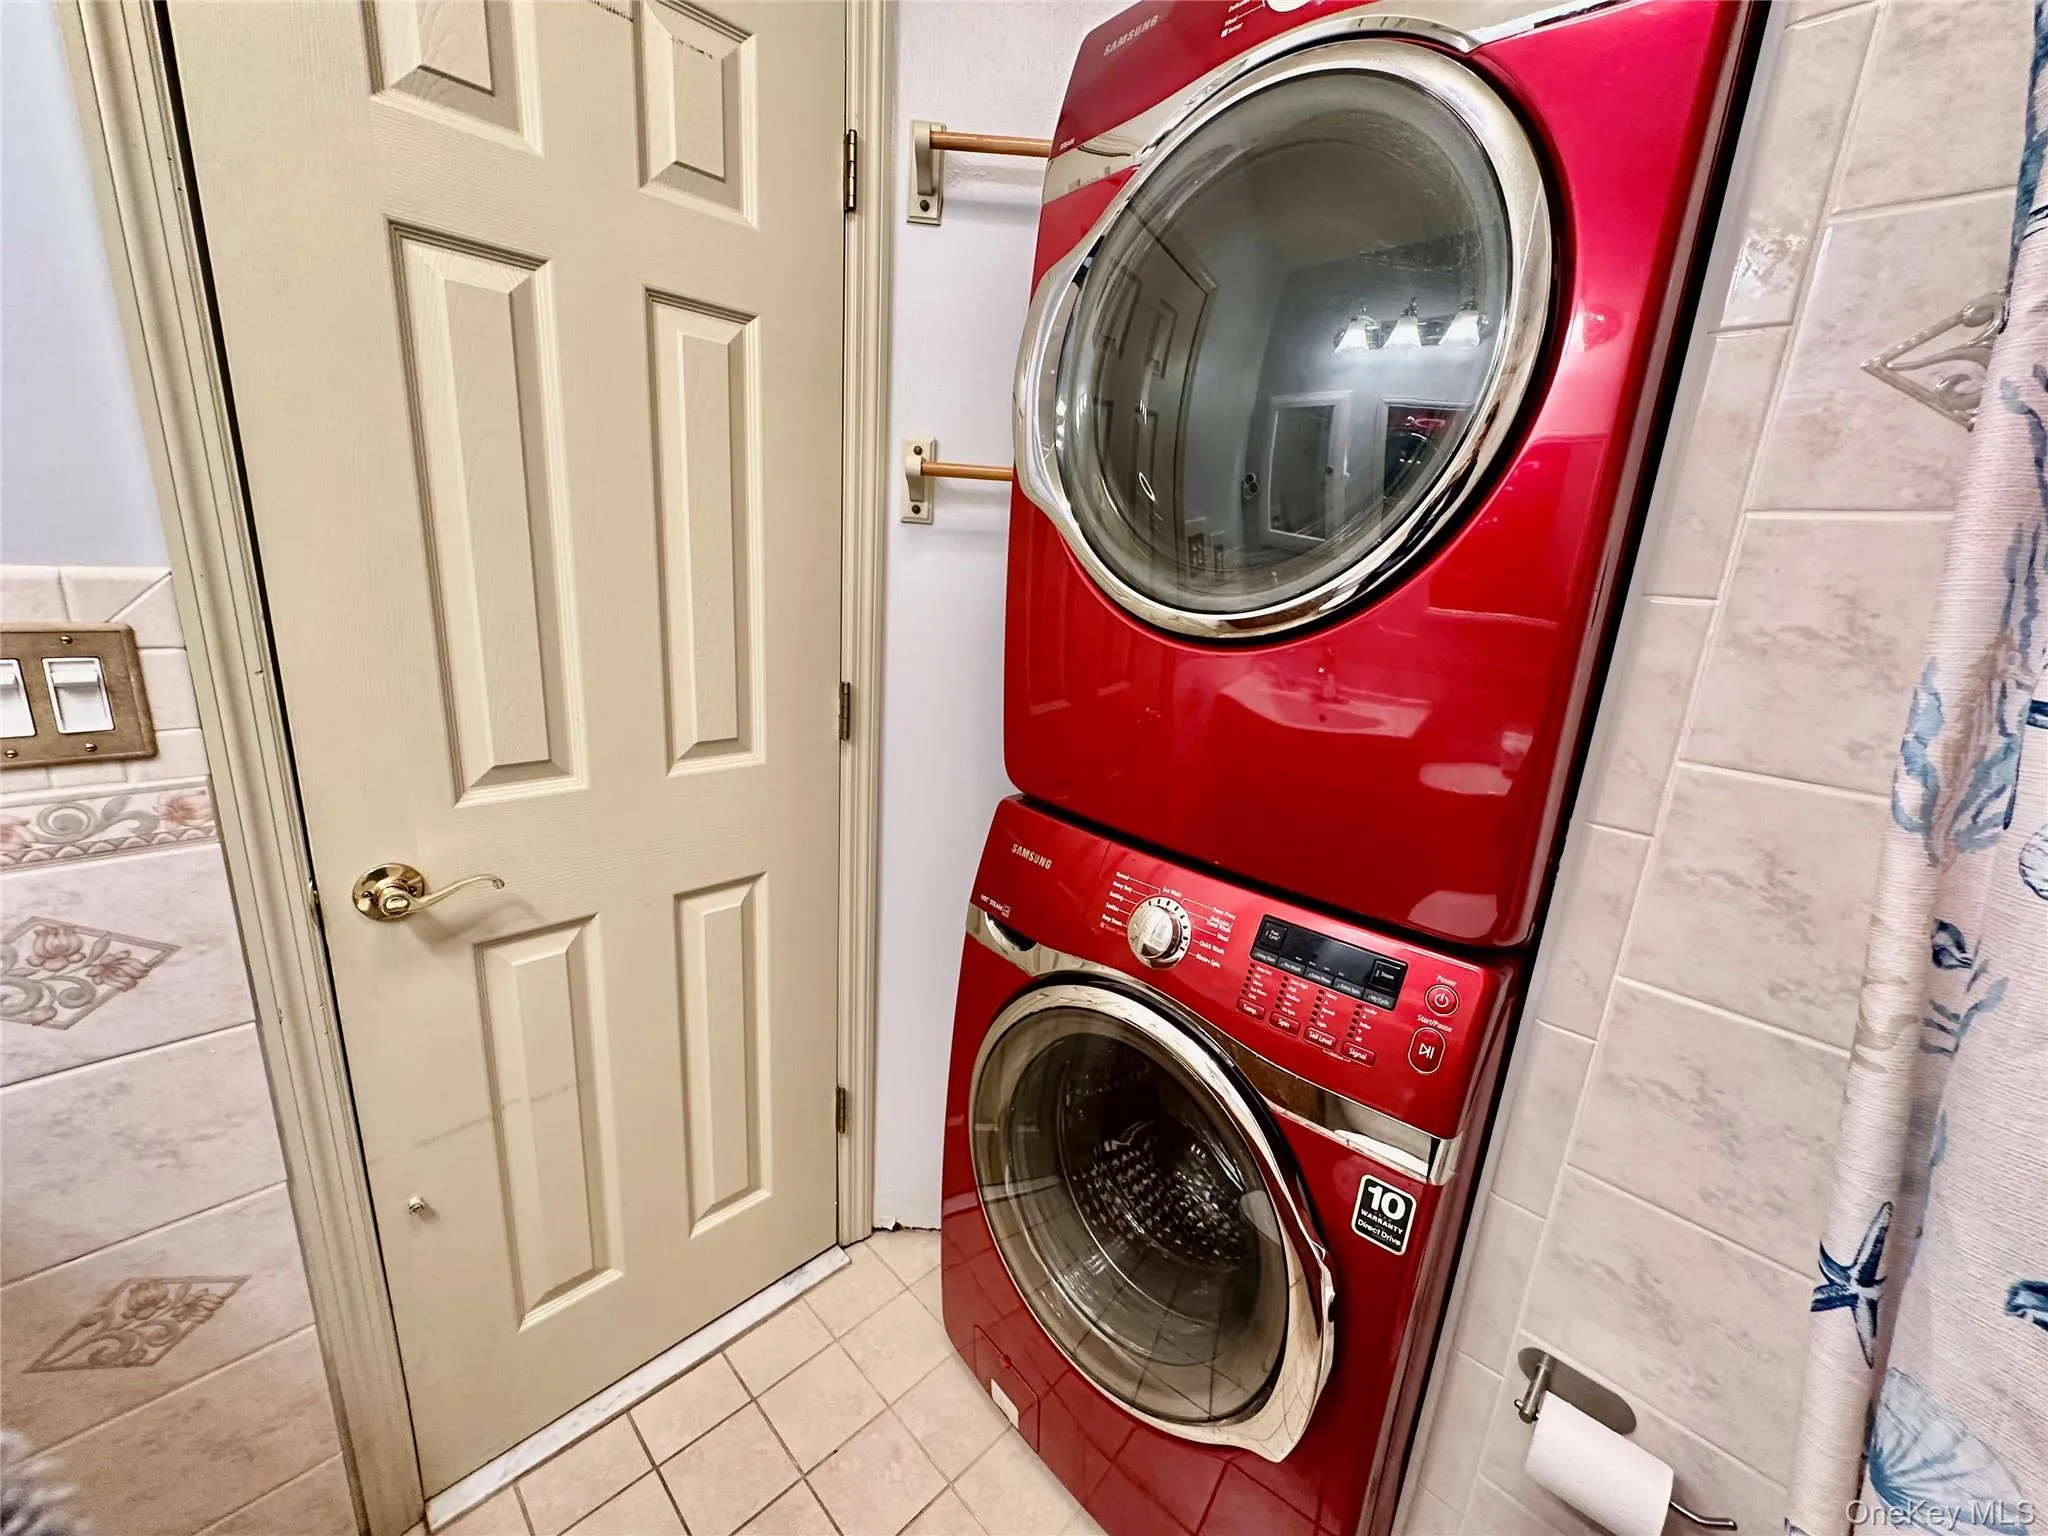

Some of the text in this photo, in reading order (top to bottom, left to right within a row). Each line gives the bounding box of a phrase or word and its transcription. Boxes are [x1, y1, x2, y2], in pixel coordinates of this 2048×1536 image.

[1103, 14, 1160, 57] SAMSUNG
[1011, 843, 1053, 870] SAMSUNG
[1199, 940, 1225, 955] Quick Wash
[1436, 974, 1457, 987] Power
[1278, 1018, 1290, 1029] Spin
[1416, 1014, 1453, 1033] Start/Pause
[1308, 1030, 1333, 1047] Soil Level
[1348, 1047, 1367, 1061] Signal
[1367, 1185, 1406, 1220] 10
[1360, 1208, 1404, 1235] WARRANTY
[1357, 1218, 1402, 1247] Direct Drive
